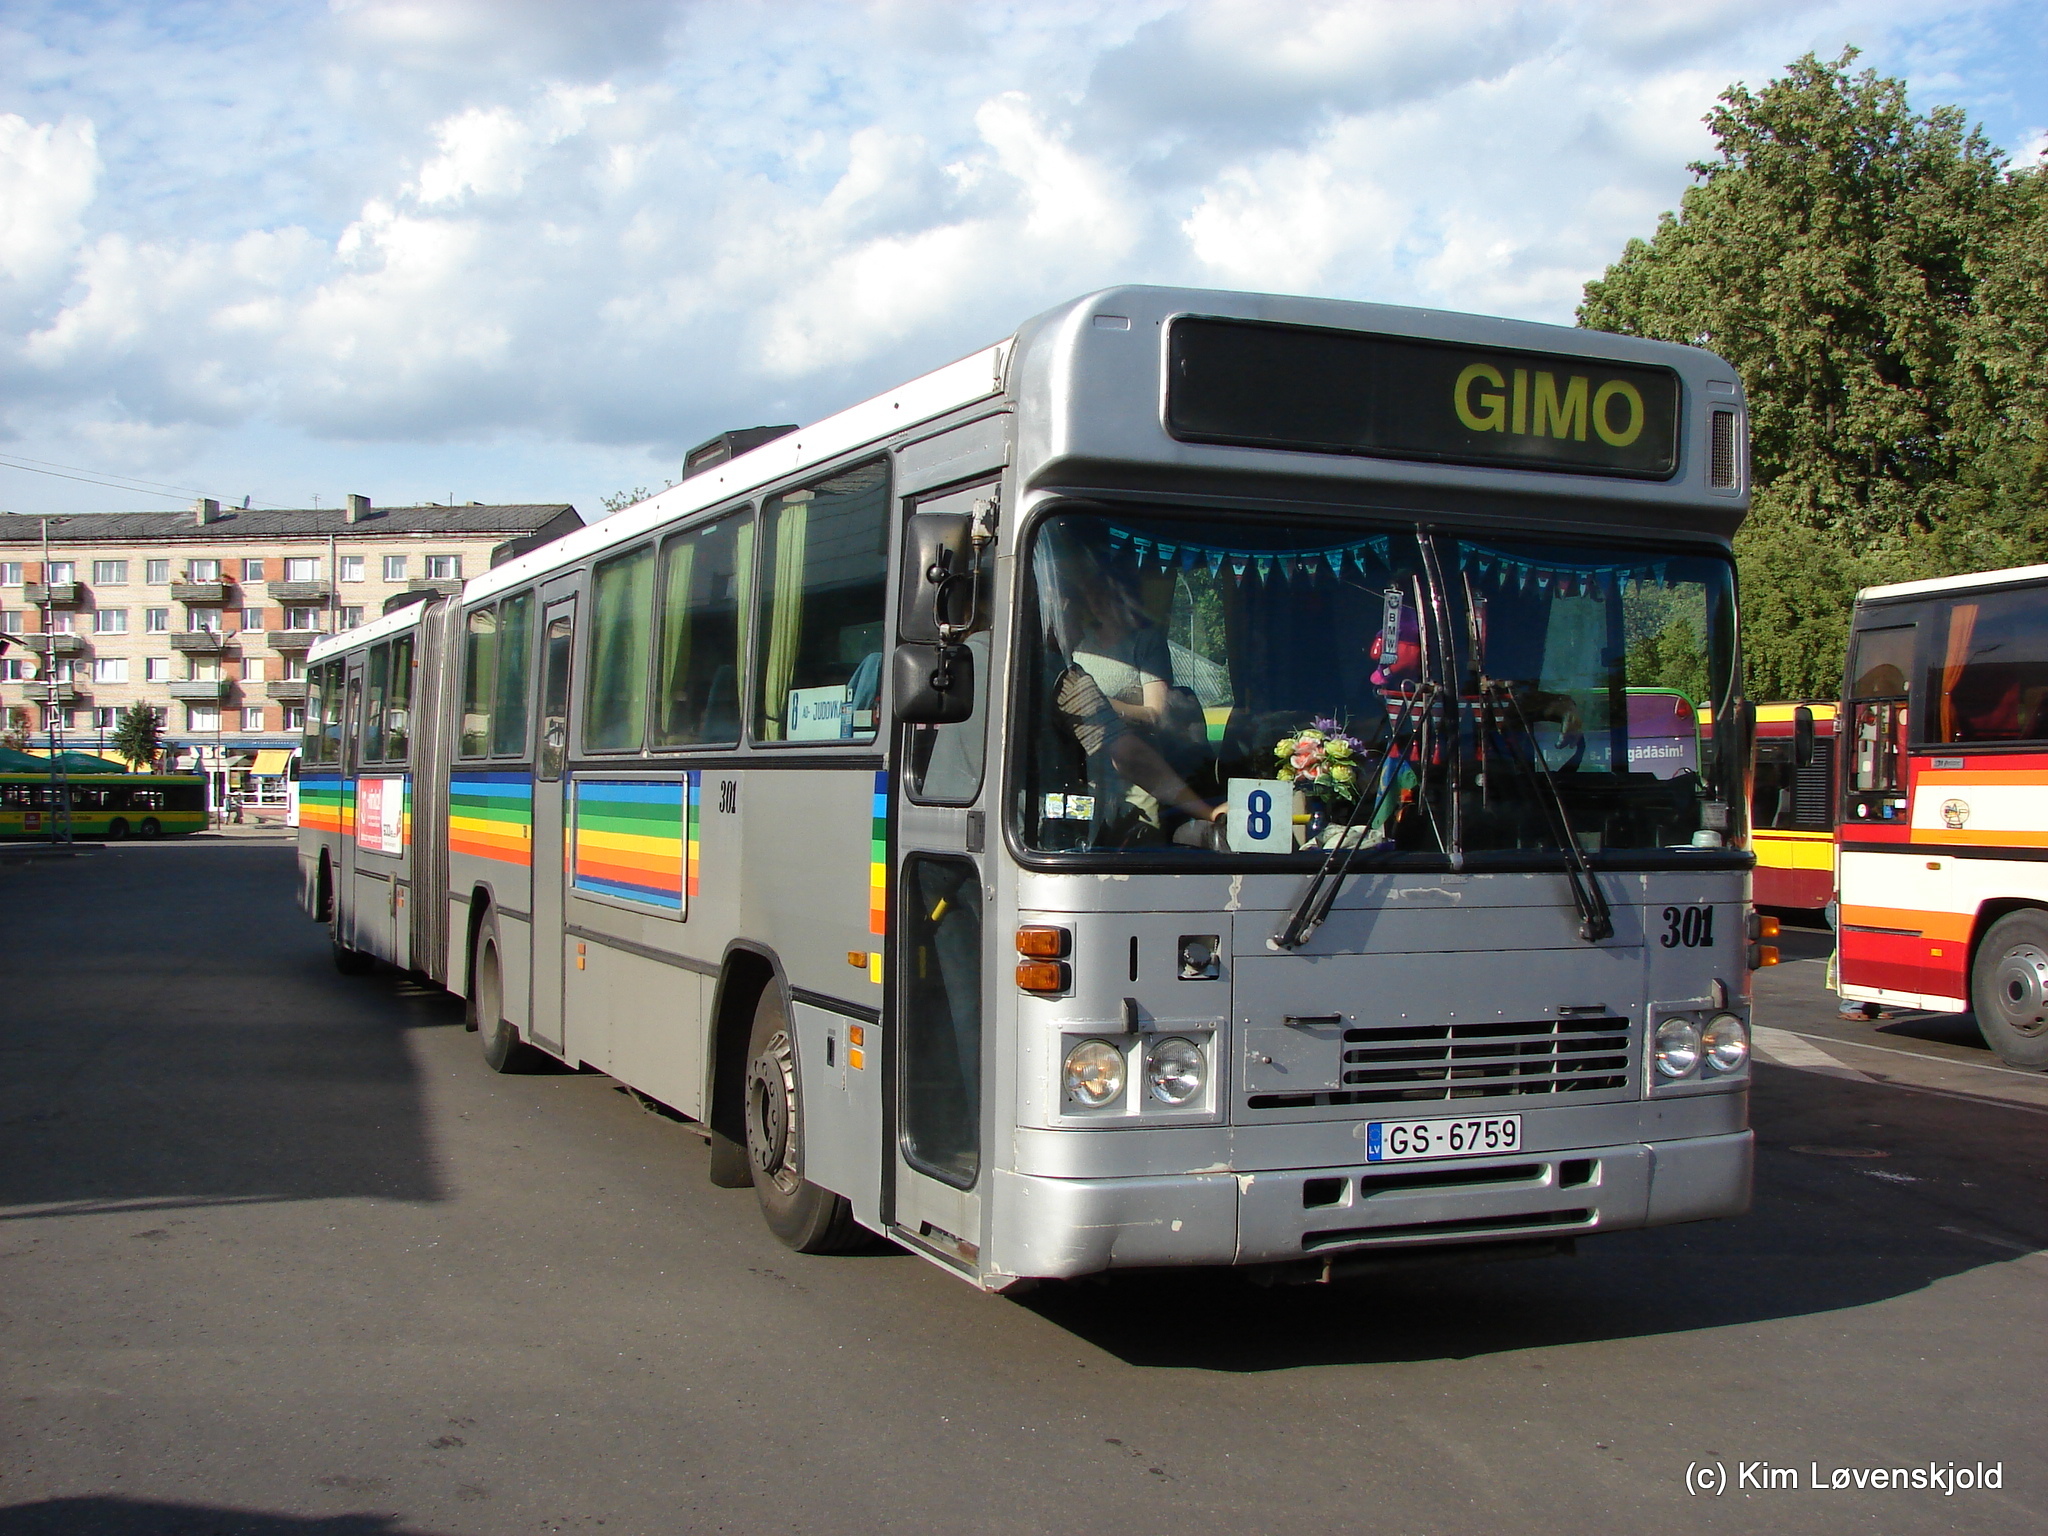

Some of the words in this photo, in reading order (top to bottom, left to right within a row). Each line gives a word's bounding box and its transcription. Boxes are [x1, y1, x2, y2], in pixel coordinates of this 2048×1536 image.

[1453, 362, 1645, 447] GIMO
[791, 692, 799, 731] 8
[719, 780, 737, 814] 301
[1247, 789, 1272, 841] 8
[1660, 904, 1714, 949] 301
[1369, 1145, 1381, 1155] LV
[1390, 1119, 1516, 1155] GS-6759
